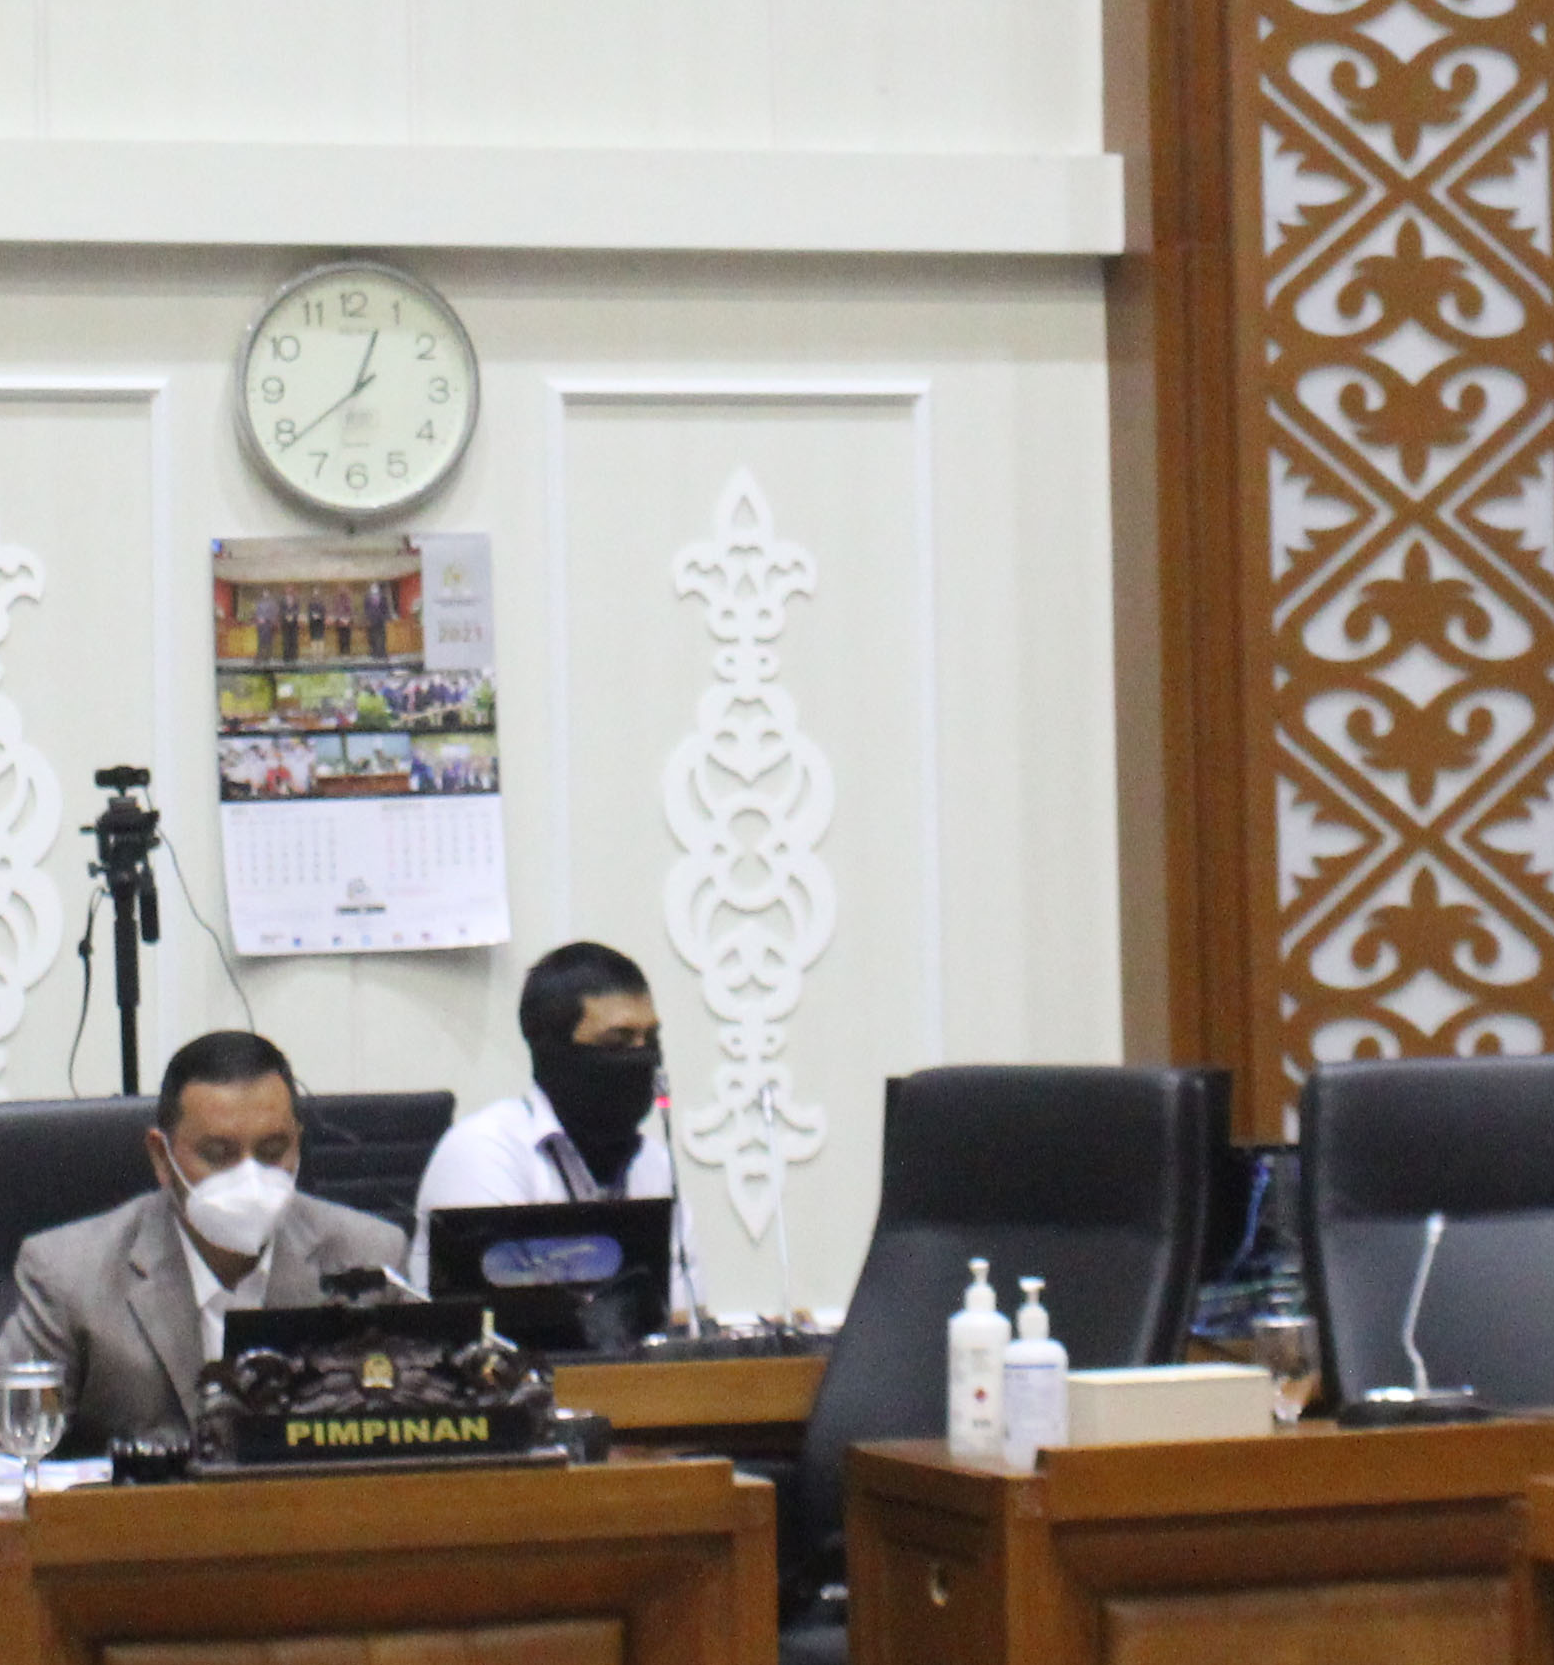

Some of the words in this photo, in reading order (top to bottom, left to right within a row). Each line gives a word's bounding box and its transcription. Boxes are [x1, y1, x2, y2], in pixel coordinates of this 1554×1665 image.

[302, 300, 324, 326] 11
[339, 291, 368, 318] 12
[271, 335, 301, 362] 10
[415, 334, 437, 360] 2
[261, 376, 285, 404] 9
[427, 377, 450, 404] 3
[275, 419, 296, 447] 8
[415, 419, 435, 444] 4
[308, 451, 329, 478] 7
[345, 463, 369, 490] 6
[386, 451, 409, 479] 5
[285, 1416, 489, 1448] PIMPINAN
